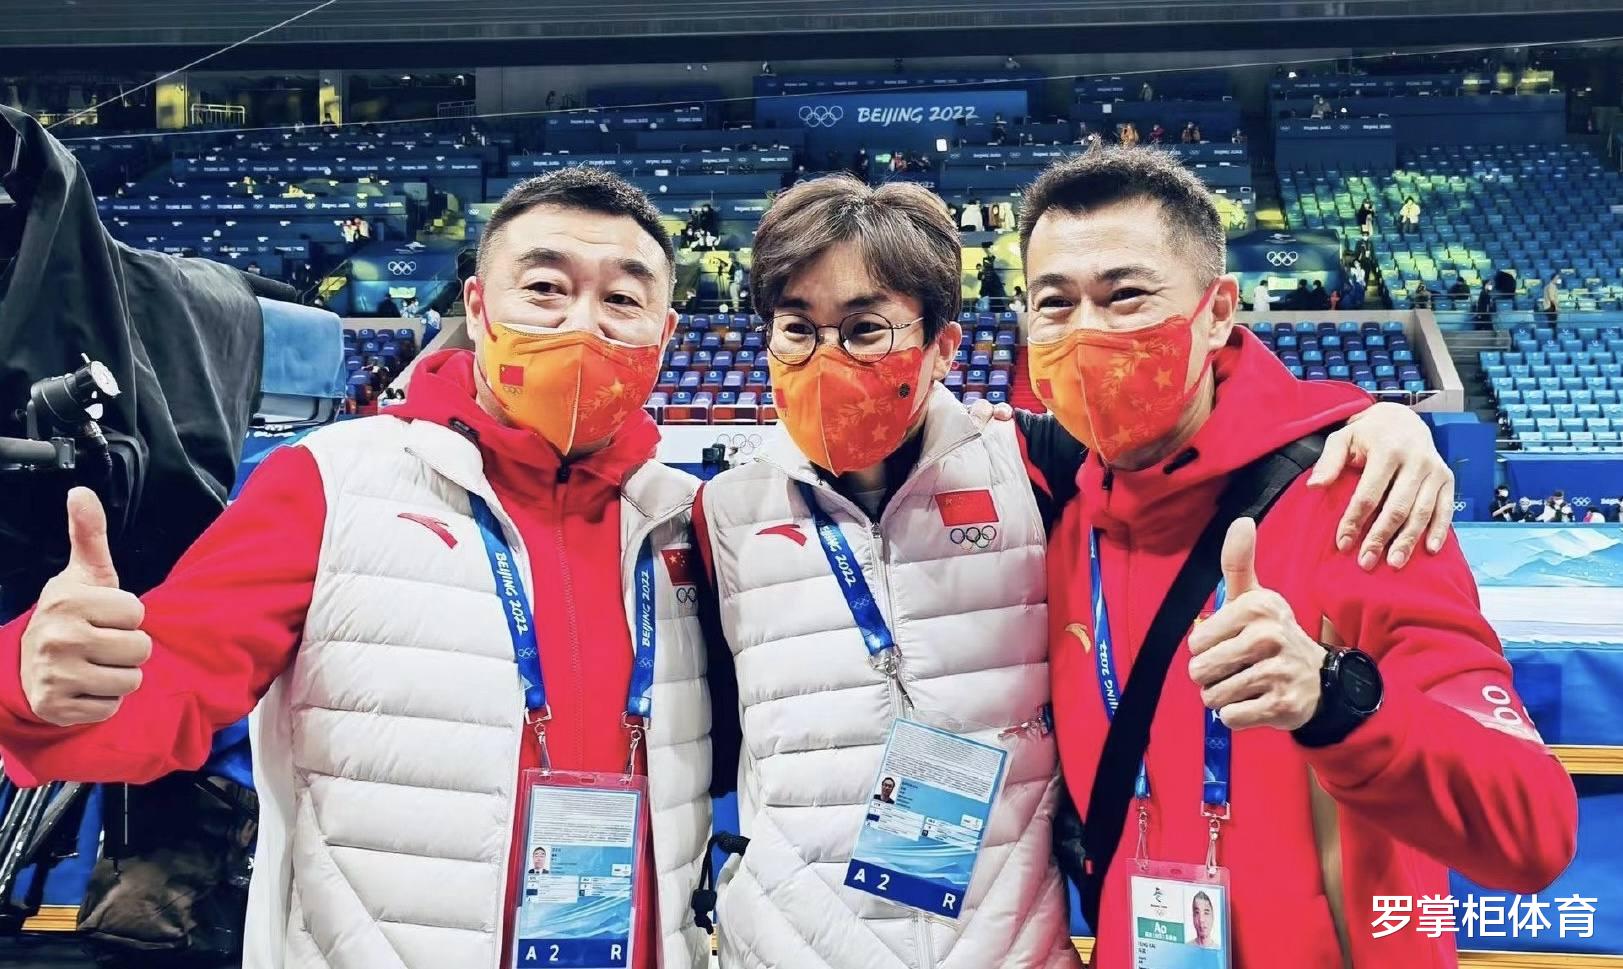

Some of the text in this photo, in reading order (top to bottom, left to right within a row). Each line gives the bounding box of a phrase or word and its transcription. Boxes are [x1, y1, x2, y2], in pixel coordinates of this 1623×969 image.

[857, 106, 979, 127] BEIJING 2022
[835, 554, 856, 588] 2022
[495, 551, 528, 636] BEIJING 2022
[641, 569, 653, 647] BEIJING 2022
[1099, 639, 1109, 676] 2022
[853, 868, 956, 910] A 2 R
[525, 944, 622, 961] A 2 R
